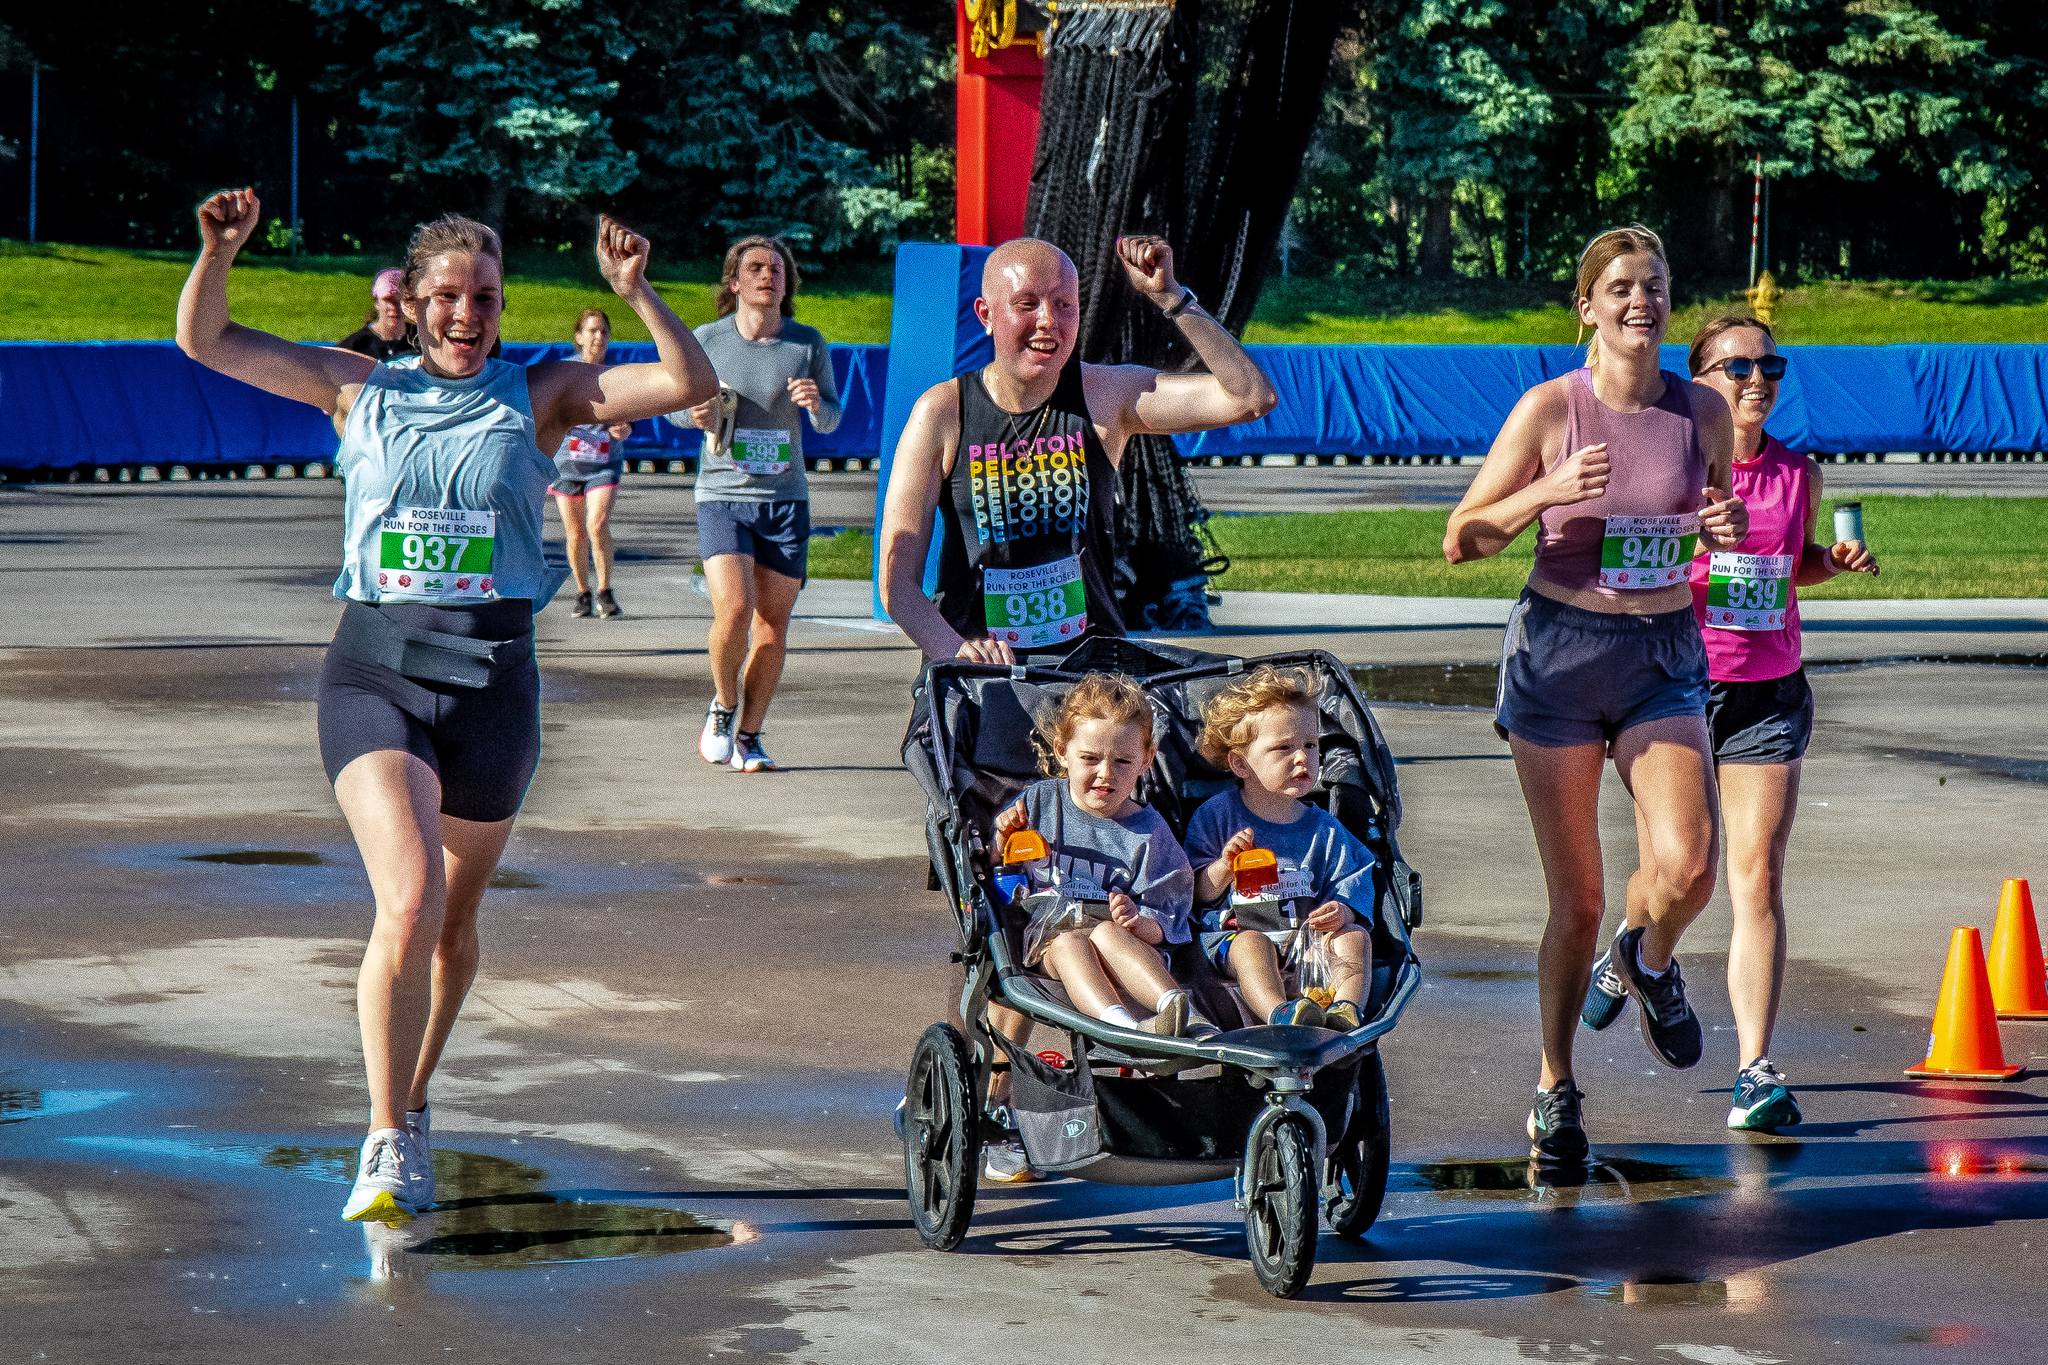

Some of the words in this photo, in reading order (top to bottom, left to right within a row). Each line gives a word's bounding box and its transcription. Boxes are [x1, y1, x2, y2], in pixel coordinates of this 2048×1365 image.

[969, 431, 1083, 461] PELOTON
[970, 447, 1086, 478] PELOTON
[971, 465, 1089, 495] PELOTON
[972, 482, 1090, 512] PELOTON
[412, 509, 466, 521] ROSEVILLE
[974, 498, 1089, 528] PELOTON
[1633, 517, 1681, 525] ROSEVILLE
[383, 521, 405, 531] RUN
[408, 522, 429, 532] FOR
[433, 523, 451, 533] THE
[454, 524, 487, 535] ROSES
[977, 514, 1087, 544] PELOTON
[1651, 527, 1667, 535] THE
[1669, 524, 1695, 535] ROSES
[402, 535, 470, 571] 937
[1622, 537, 1681, 567] 940
[1737, 556, 1779, 565] ROSEVILLE
[986, 582, 1005, 592] RUN
[1008, 583, 1028, 592] FOR
[1032, 579, 1048, 589] THE
[1050, 570, 1076, 586] ROSES
[1010, 564, 1060, 580] ROSEVILLE
[1712, 564, 1731, 573] RUN
[1733, 566, 1752, 575] FOR
[1754, 568, 1768, 576] THE
[1727, 577, 1778, 610] 939
[1005, 587, 1067, 626] 938
[1079, 882, 1090, 890] for
[1260, 894, 1279, 902] Kids
[1282, 891, 1298, 899] Fun
[1266, 882, 1284, 892] Roll
[1286, 880, 1298, 889] for
[1281, 900, 1298, 928] 1
